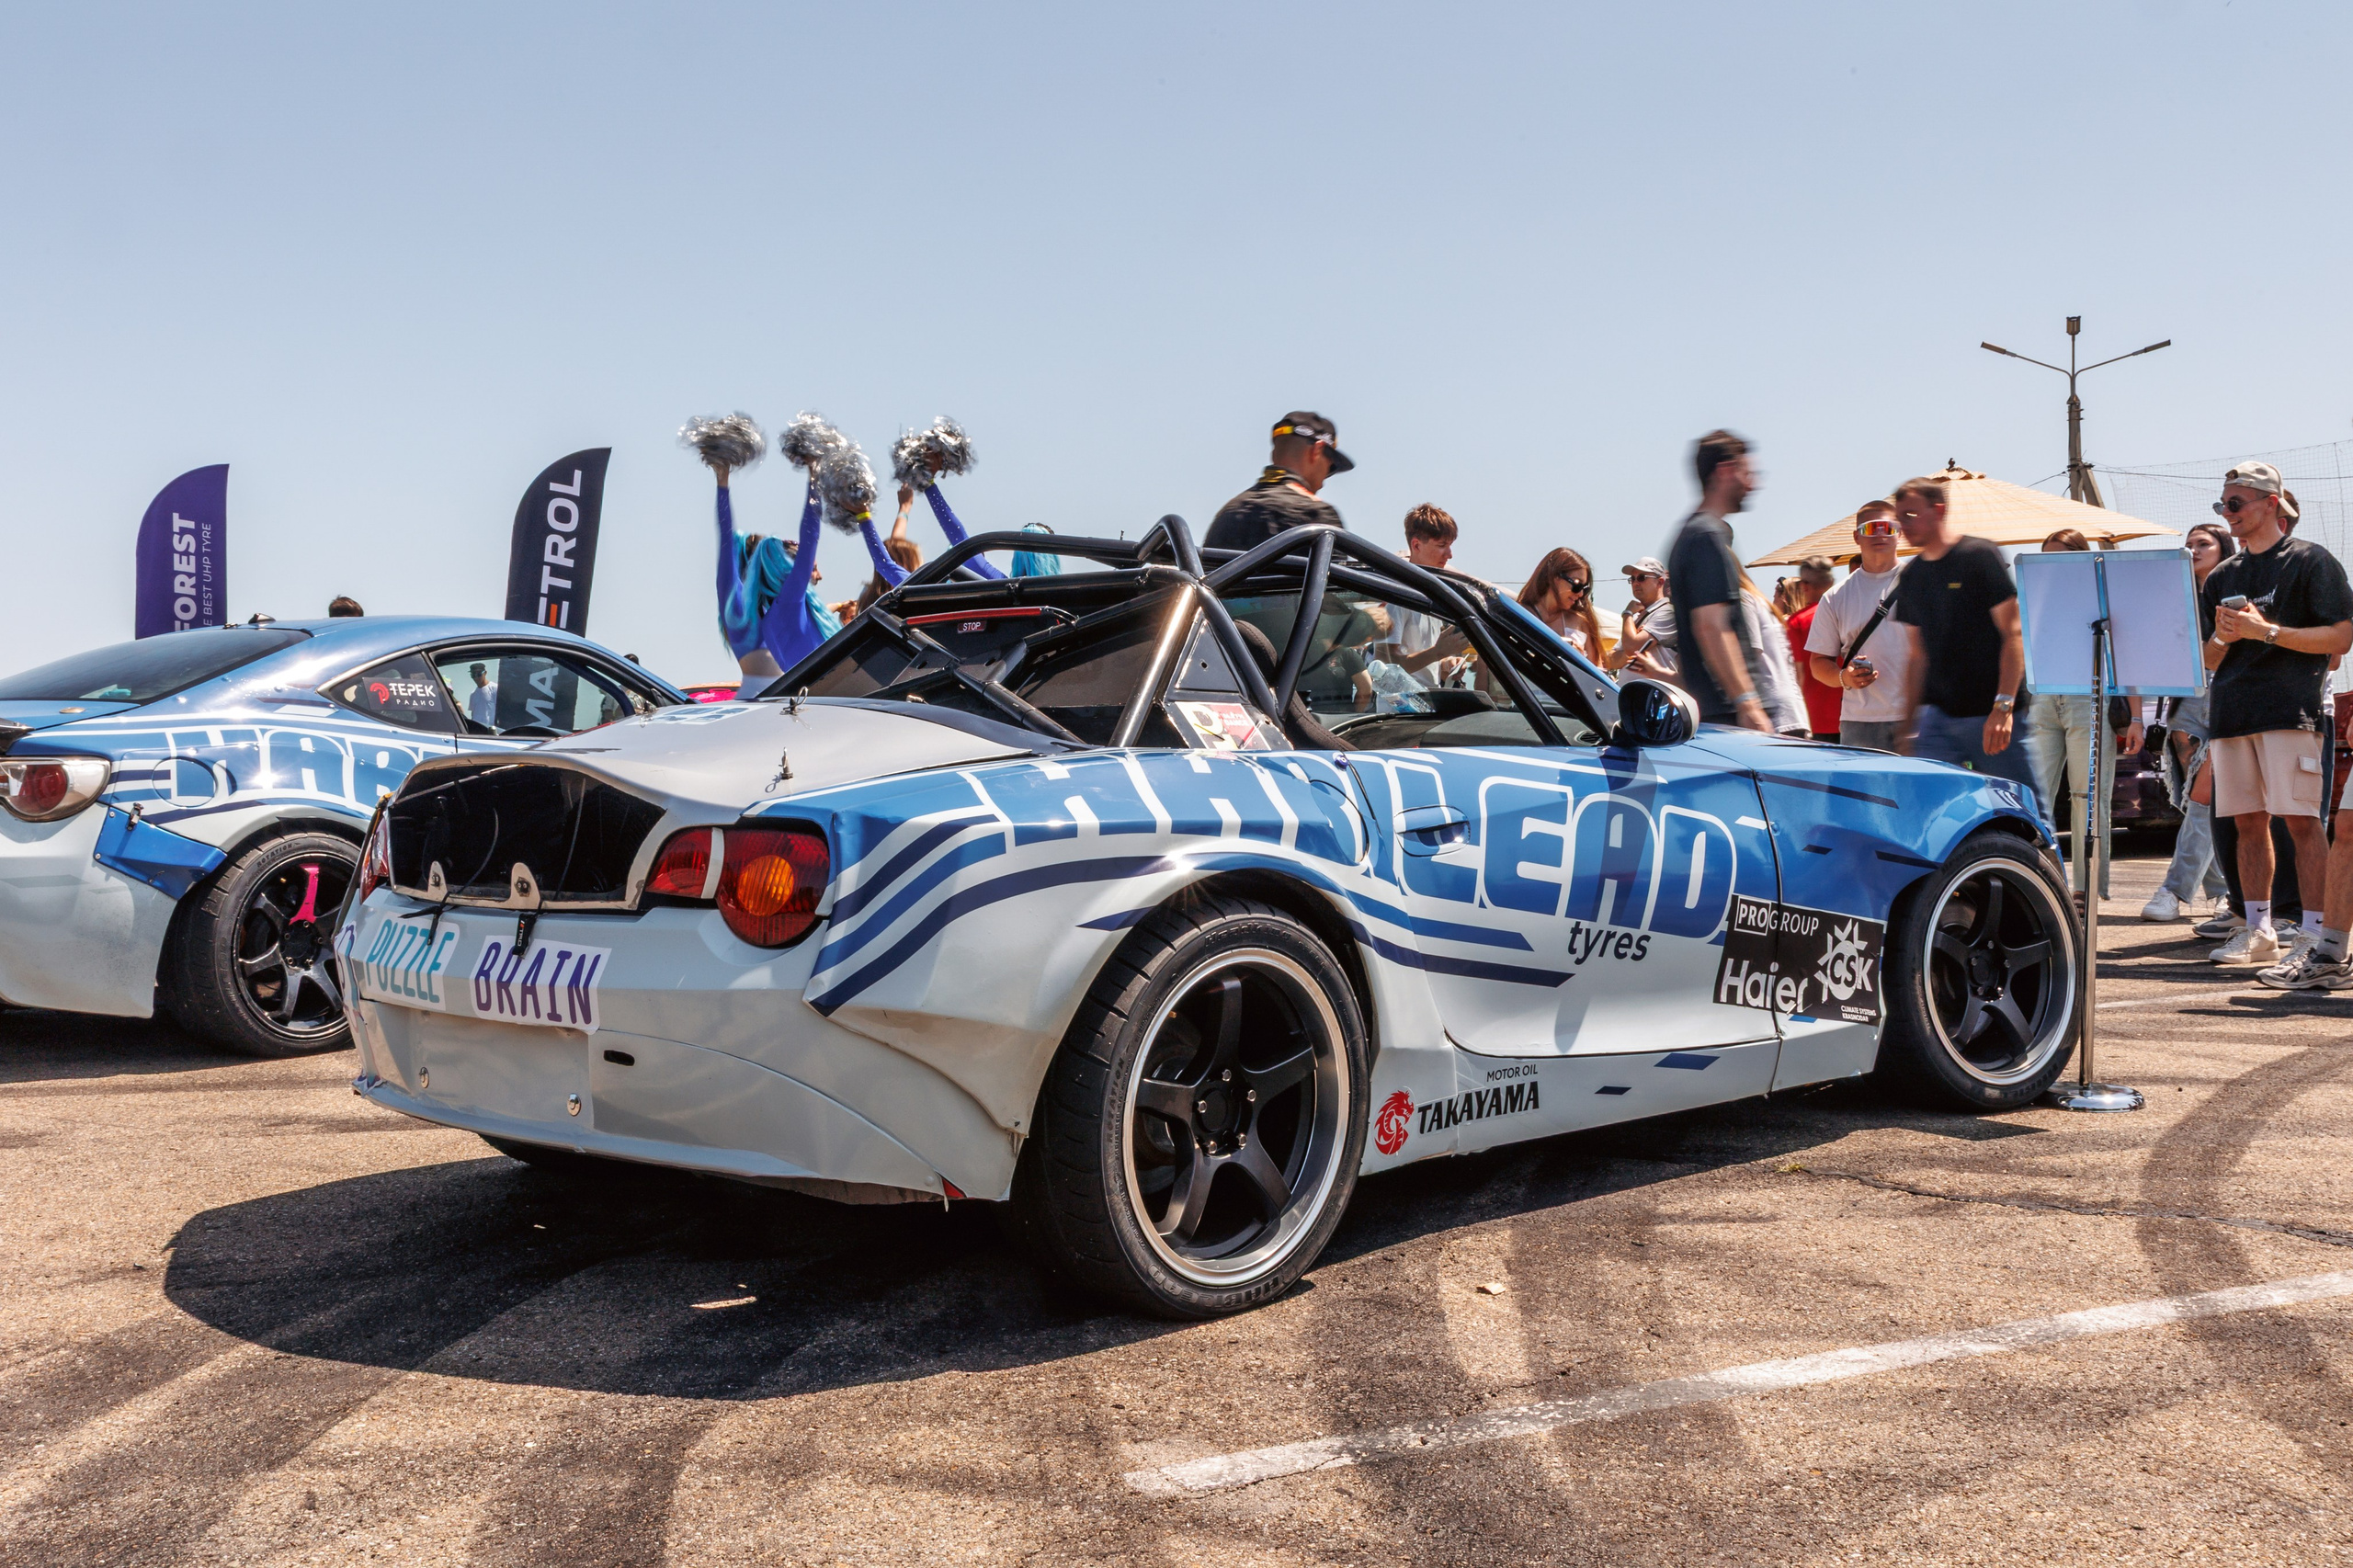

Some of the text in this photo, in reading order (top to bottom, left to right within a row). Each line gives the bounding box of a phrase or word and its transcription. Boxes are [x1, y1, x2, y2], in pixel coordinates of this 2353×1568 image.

[201, 522, 211, 553] TYRE
[173, 513, 197, 632] FOREST
[202, 556, 212, 582] UHP
[202, 585, 212, 615] BEST
[962, 621, 981, 631] STOP
[367, 919, 455, 1003] PUZZLE
[1567, 921, 1652, 965] tyres
[474, 941, 601, 1025] BRAIN
[1720, 958, 1809, 1013] Haier
[1841, 1005, 1877, 1017] CLIMATE SYSTEMS
[1486, 1064, 1539, 1082] MOTOR OIL
[1417, 1081, 1540, 1135] TAKAYAMA
